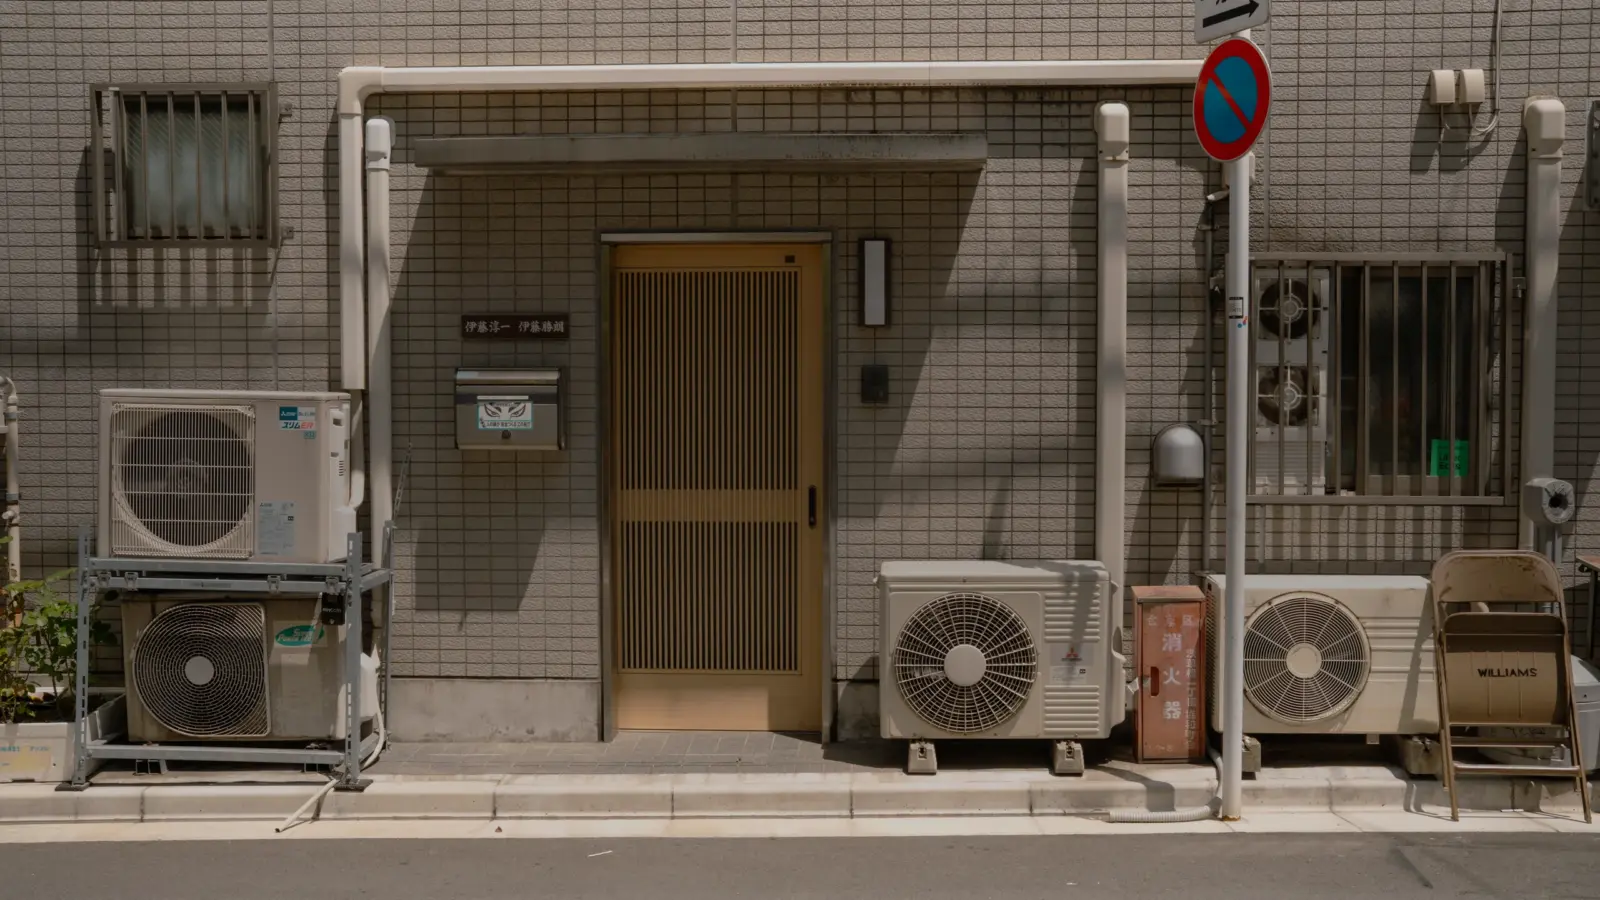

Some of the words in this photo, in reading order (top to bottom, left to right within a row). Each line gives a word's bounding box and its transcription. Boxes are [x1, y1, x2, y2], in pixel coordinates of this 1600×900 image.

[1161, 632, 1183, 720] 消火器
[1477, 667, 1538, 678] WILLIAMS
